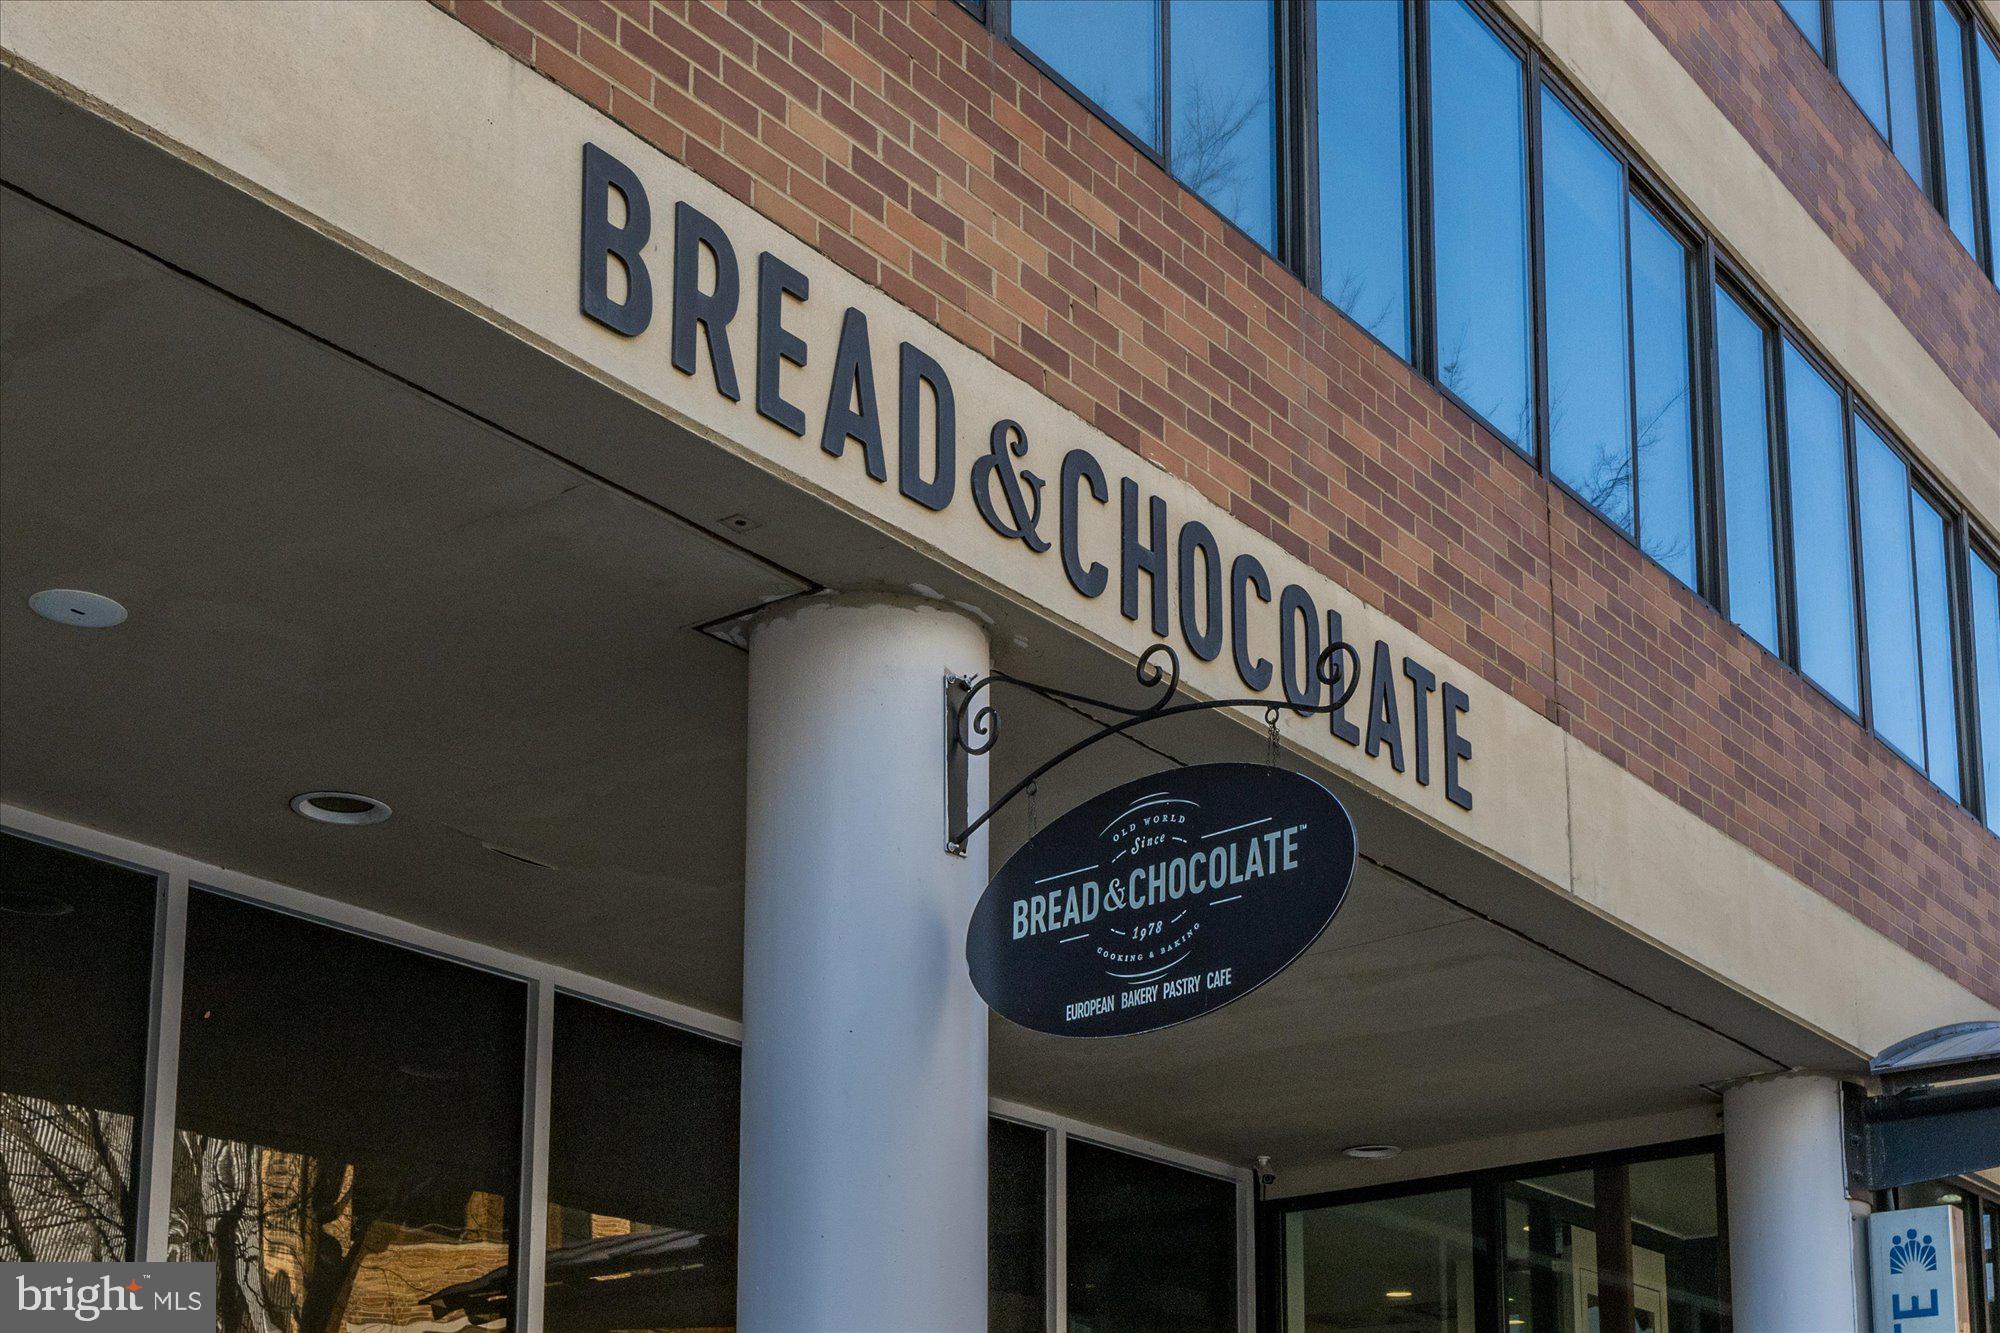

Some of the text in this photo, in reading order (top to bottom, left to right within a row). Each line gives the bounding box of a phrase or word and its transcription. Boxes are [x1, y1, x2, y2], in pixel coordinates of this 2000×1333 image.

[1112, 814, 1186, 842] OLD WORLD
[1131, 833, 1166, 855] Since
[1097, 922, 1200, 962] COOKING & BAKING
[1132, 920, 1163, 941] 1978
[1066, 967, 1232, 1022] EUROPEAN BAKERY PASTRY CAFE
